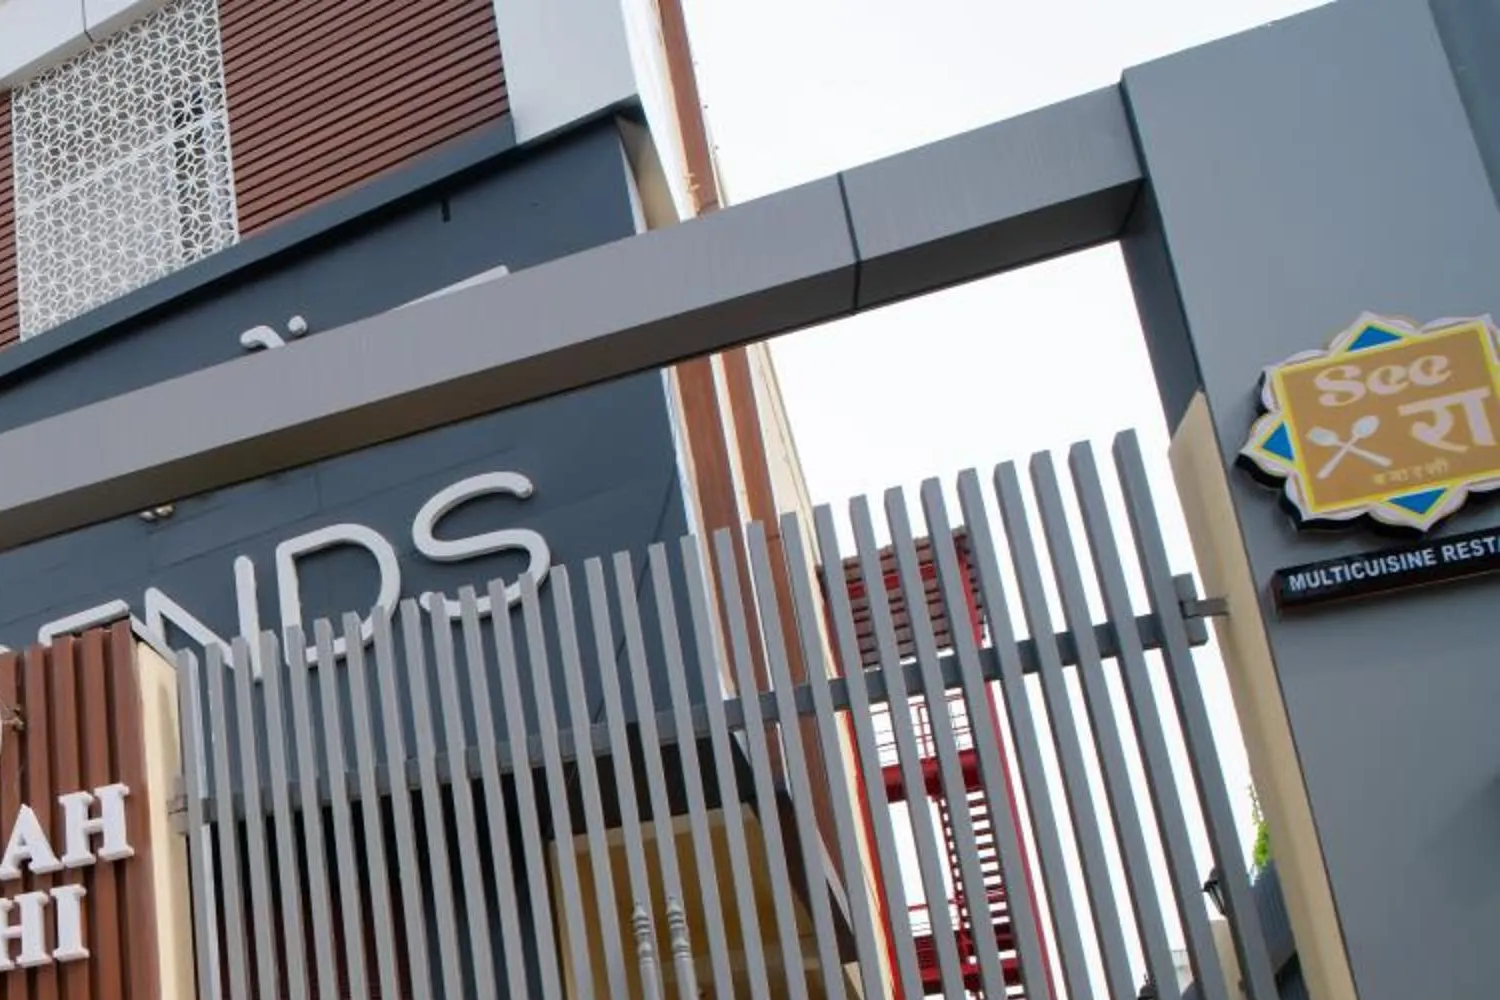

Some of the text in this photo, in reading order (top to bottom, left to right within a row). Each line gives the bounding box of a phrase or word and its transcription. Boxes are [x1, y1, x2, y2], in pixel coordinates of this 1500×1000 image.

[1313, 354, 1451, 406] See
[1288, 535, 1500, 592] MULTICUISINE REST
